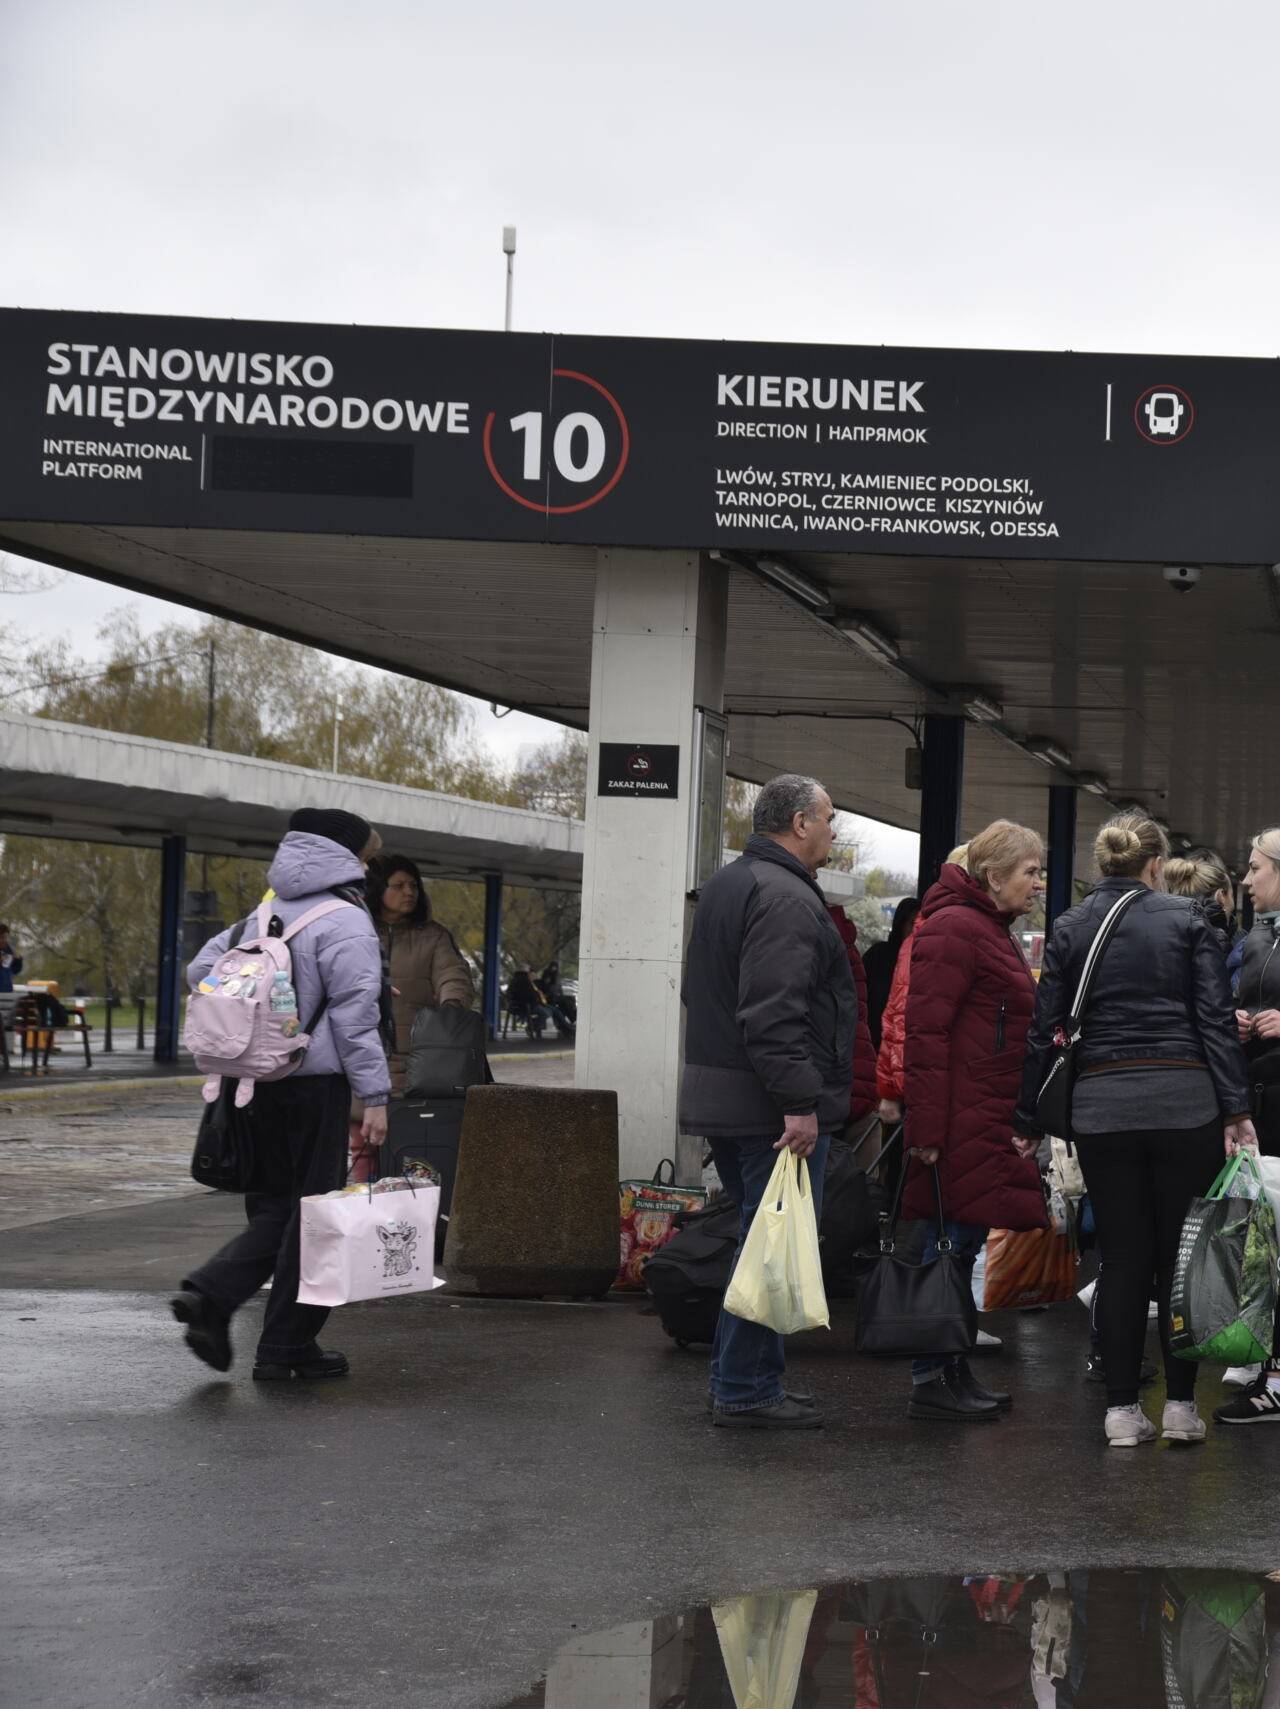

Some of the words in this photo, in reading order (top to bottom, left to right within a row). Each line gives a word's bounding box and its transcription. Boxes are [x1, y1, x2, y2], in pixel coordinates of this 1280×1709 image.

[46, 342, 334, 388] STANOWISKO
[717, 374, 925, 413] KIERUNEK
[46, 383, 470, 434] MIĘDZYNARODOWE
[717, 421, 808, 439] DIRECTION
[828, 426, 928, 443] НАПРЯМОК
[43, 438, 193, 461] INTERNATIONAL
[509, 411, 606, 483] 10
[42, 461, 142, 480] PLATFORM
[716, 466, 777, 488] LWÓW,
[781, 472, 836, 490] STRYJ,
[840, 473, 937, 491] KAMIENIEC
[941, 476, 1035, 495] PODOLSKI,
[716, 491, 816, 511] TARNOPOL,
[821, 494, 936, 513] CZERNIOWCE
[945, 494, 1044, 516] KISZYNIÓW
[715, 513, 799, 532] WINNICA,
[803, 517, 986, 538] IWANO-FRANKOWSK,
[990, 521, 1060, 537] ODESSA
[608, 780, 635, 789] ZAKAZ
[635, 782, 669, 790] PALENIA
